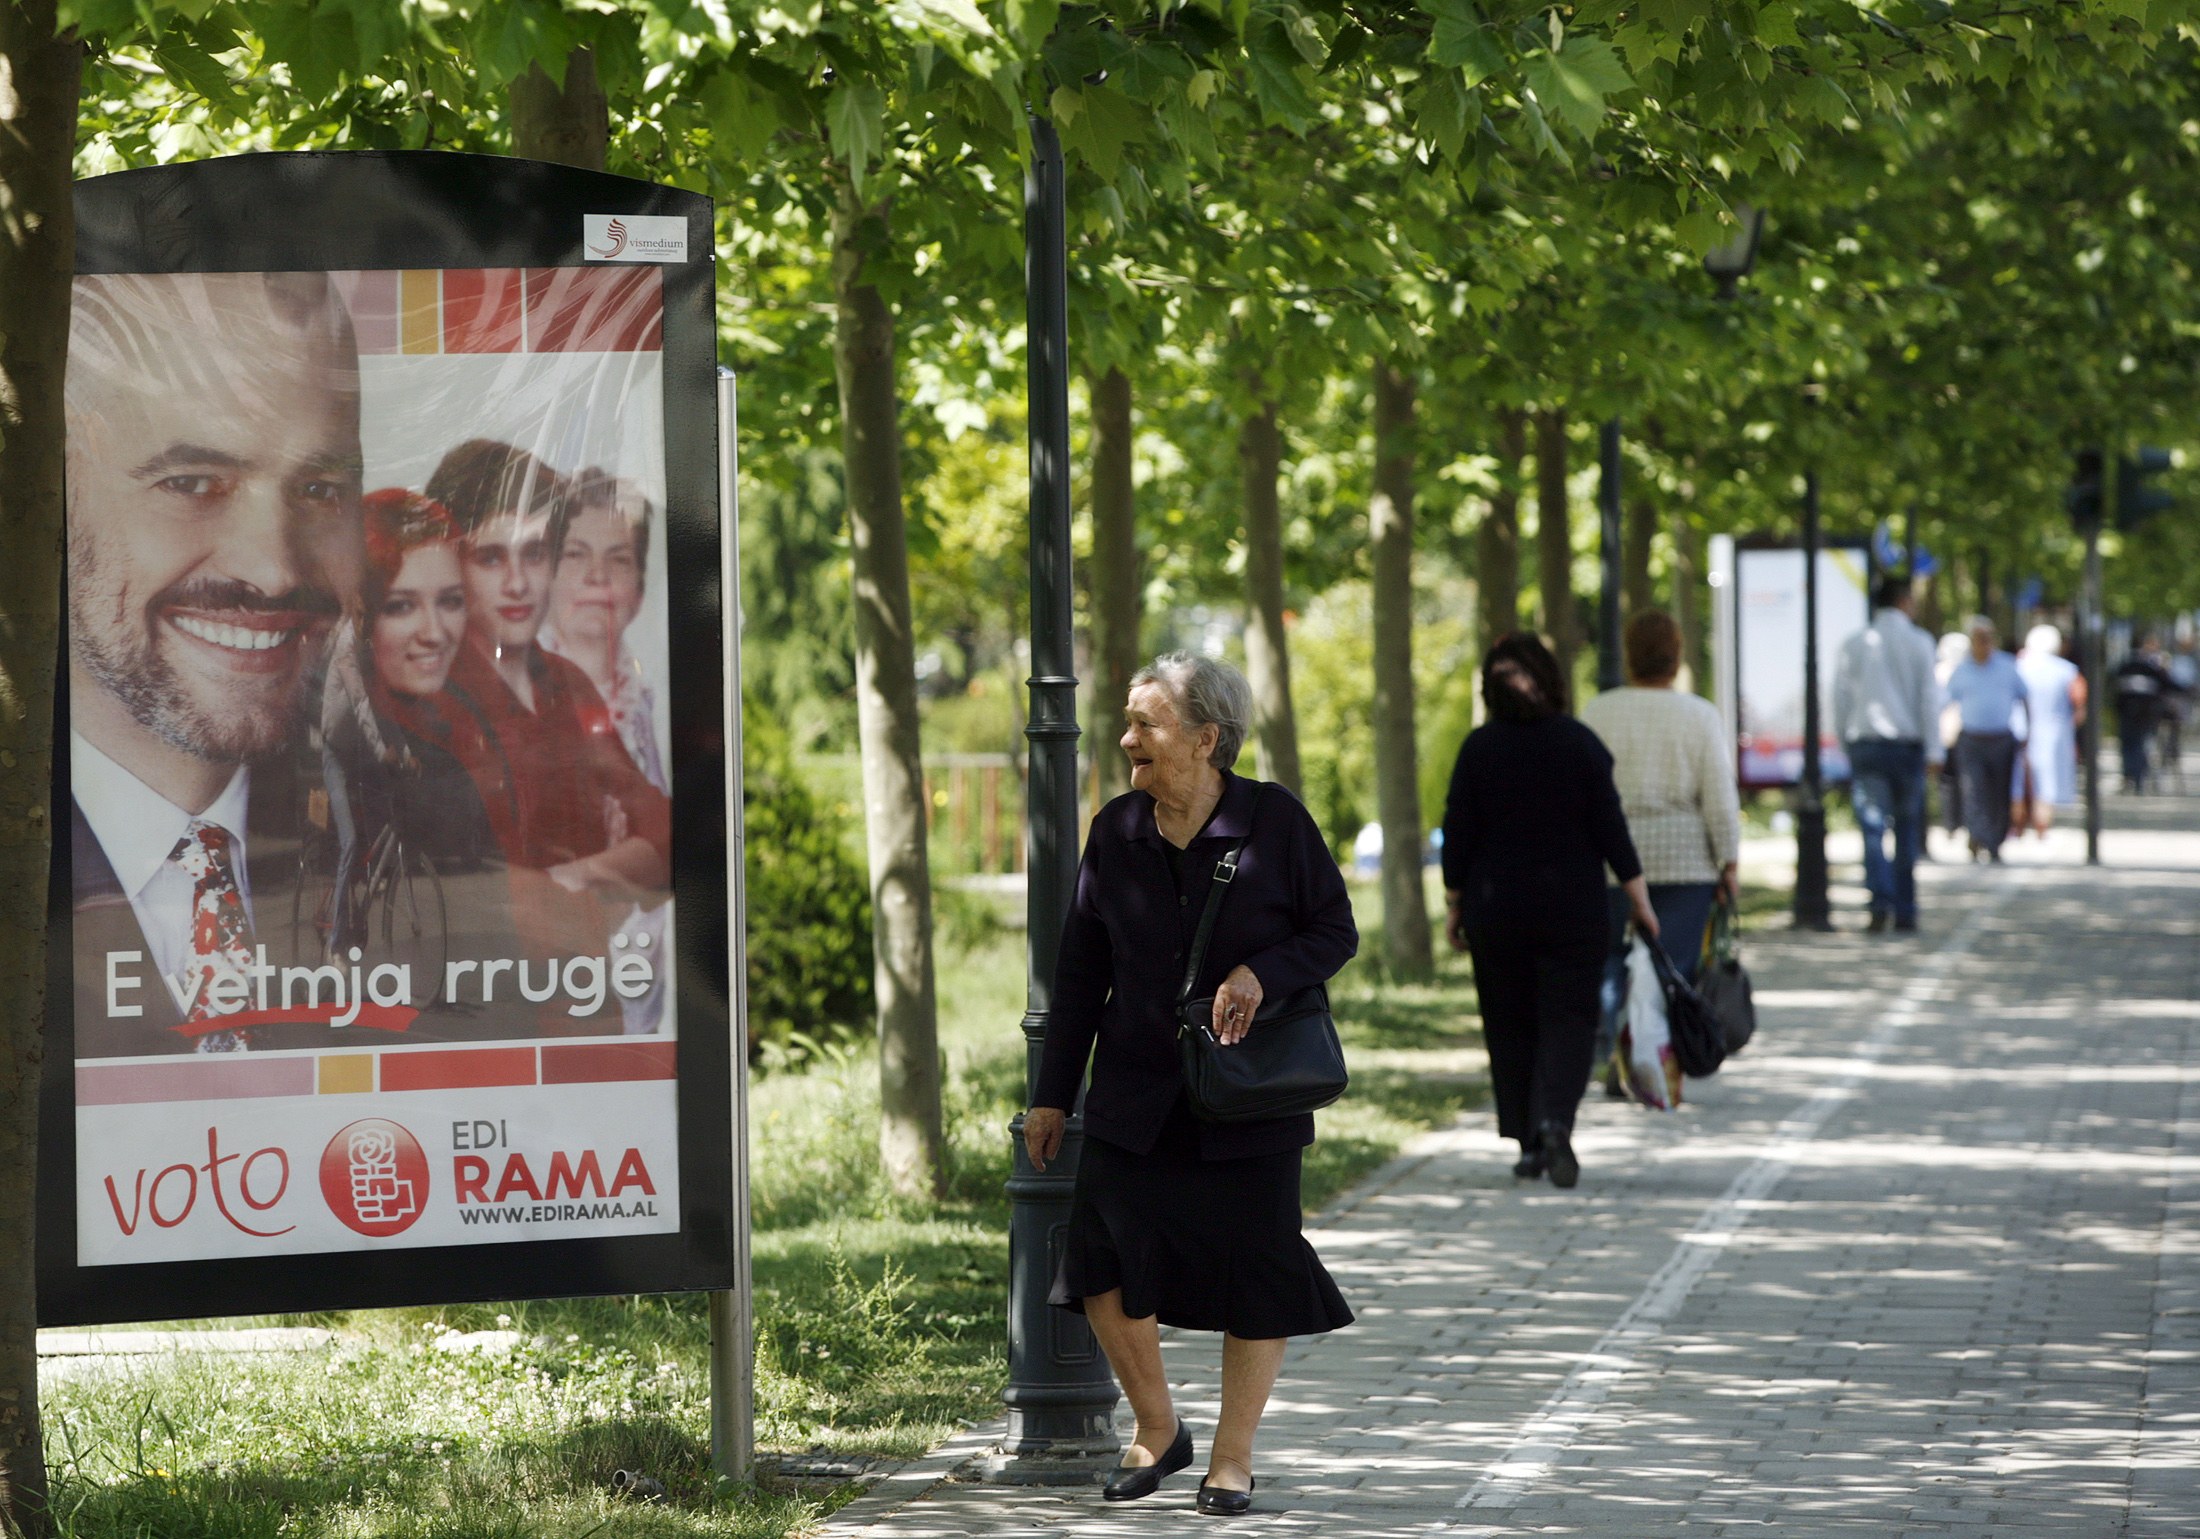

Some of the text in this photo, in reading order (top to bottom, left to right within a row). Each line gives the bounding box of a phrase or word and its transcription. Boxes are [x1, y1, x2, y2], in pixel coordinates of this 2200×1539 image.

[629, 238, 684, 248] vismedium
[107, 932, 653, 1028] E vetmja rrugë
[452, 1119, 507, 1150] EDI
[104, 1126, 297, 1238] voto
[453, 1148, 657, 1204] RAMA
[459, 1201, 658, 1225] WWW.EDIRAMA.AL
